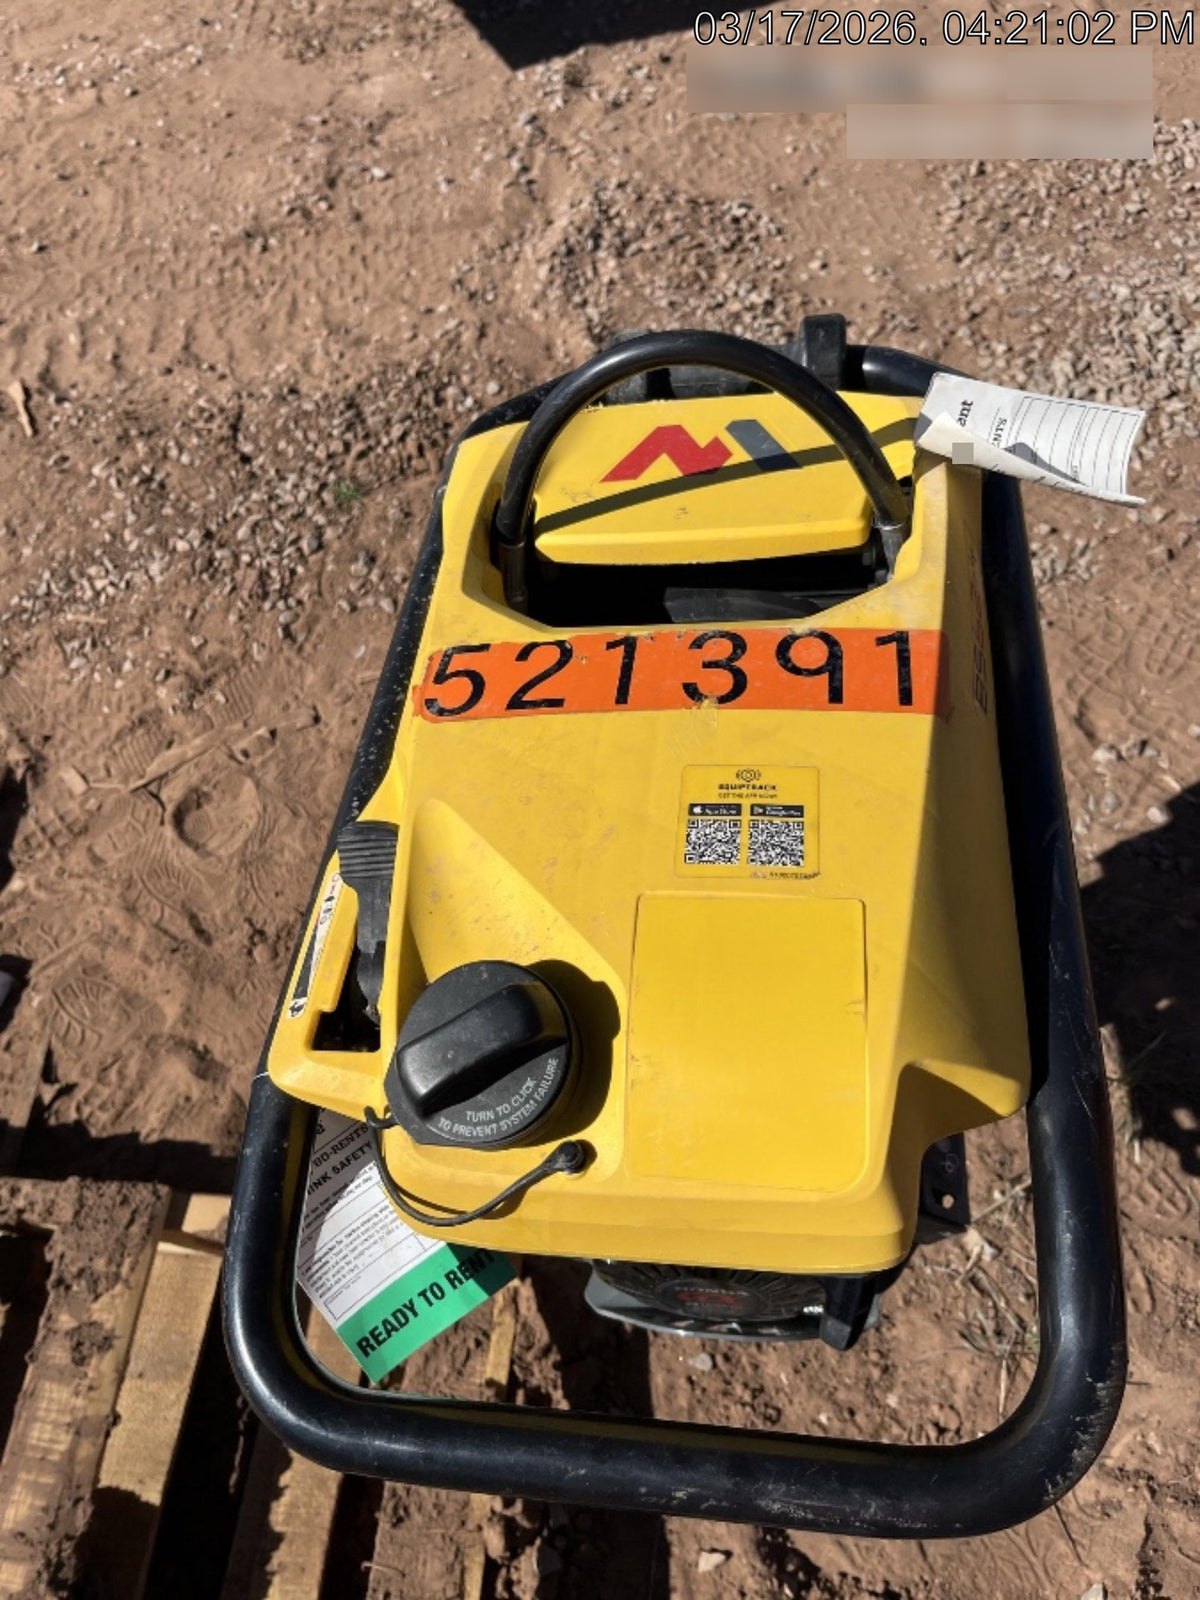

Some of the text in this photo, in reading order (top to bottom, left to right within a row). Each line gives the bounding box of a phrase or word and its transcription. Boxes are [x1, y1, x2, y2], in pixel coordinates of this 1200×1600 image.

[423, 630, 914, 717] 521391
[438, 1057, 559, 1137] TO PREVENT SYSTEM FAILURE
[466, 1077, 538, 1122] TURN TO CLICK
[332, 1141, 374, 1177] SAFETY
[356, 1298, 421, 1358] READY
[418, 1282, 446, 1308] TO
[445, 1249, 496, 1291] RENT
